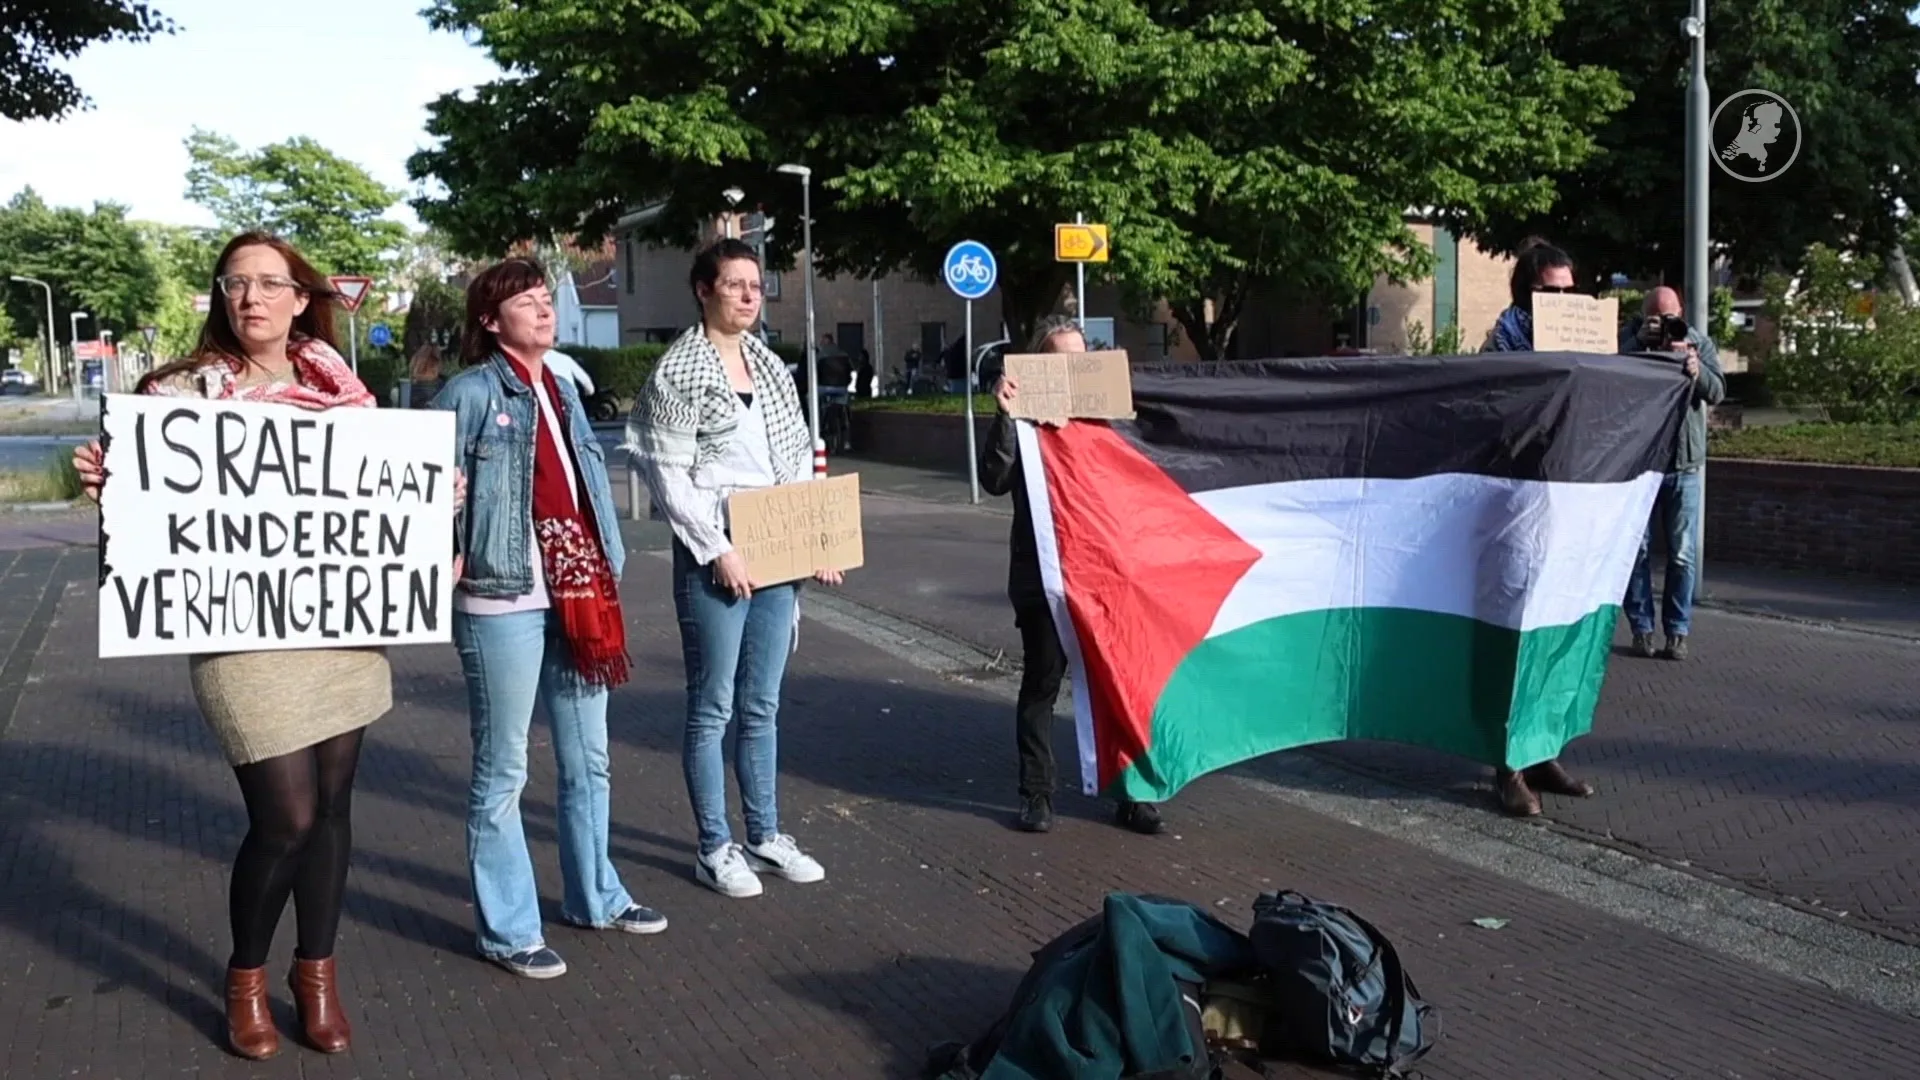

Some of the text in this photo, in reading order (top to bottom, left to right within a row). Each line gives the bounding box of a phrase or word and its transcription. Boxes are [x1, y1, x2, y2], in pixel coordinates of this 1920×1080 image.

[135, 408, 443, 504] ISRAEL LAAT
[167, 508, 410, 558] KINDEREN
[756, 486, 854, 523] VREDE VOOR
[114, 563, 438, 639] VERHONGEREN
